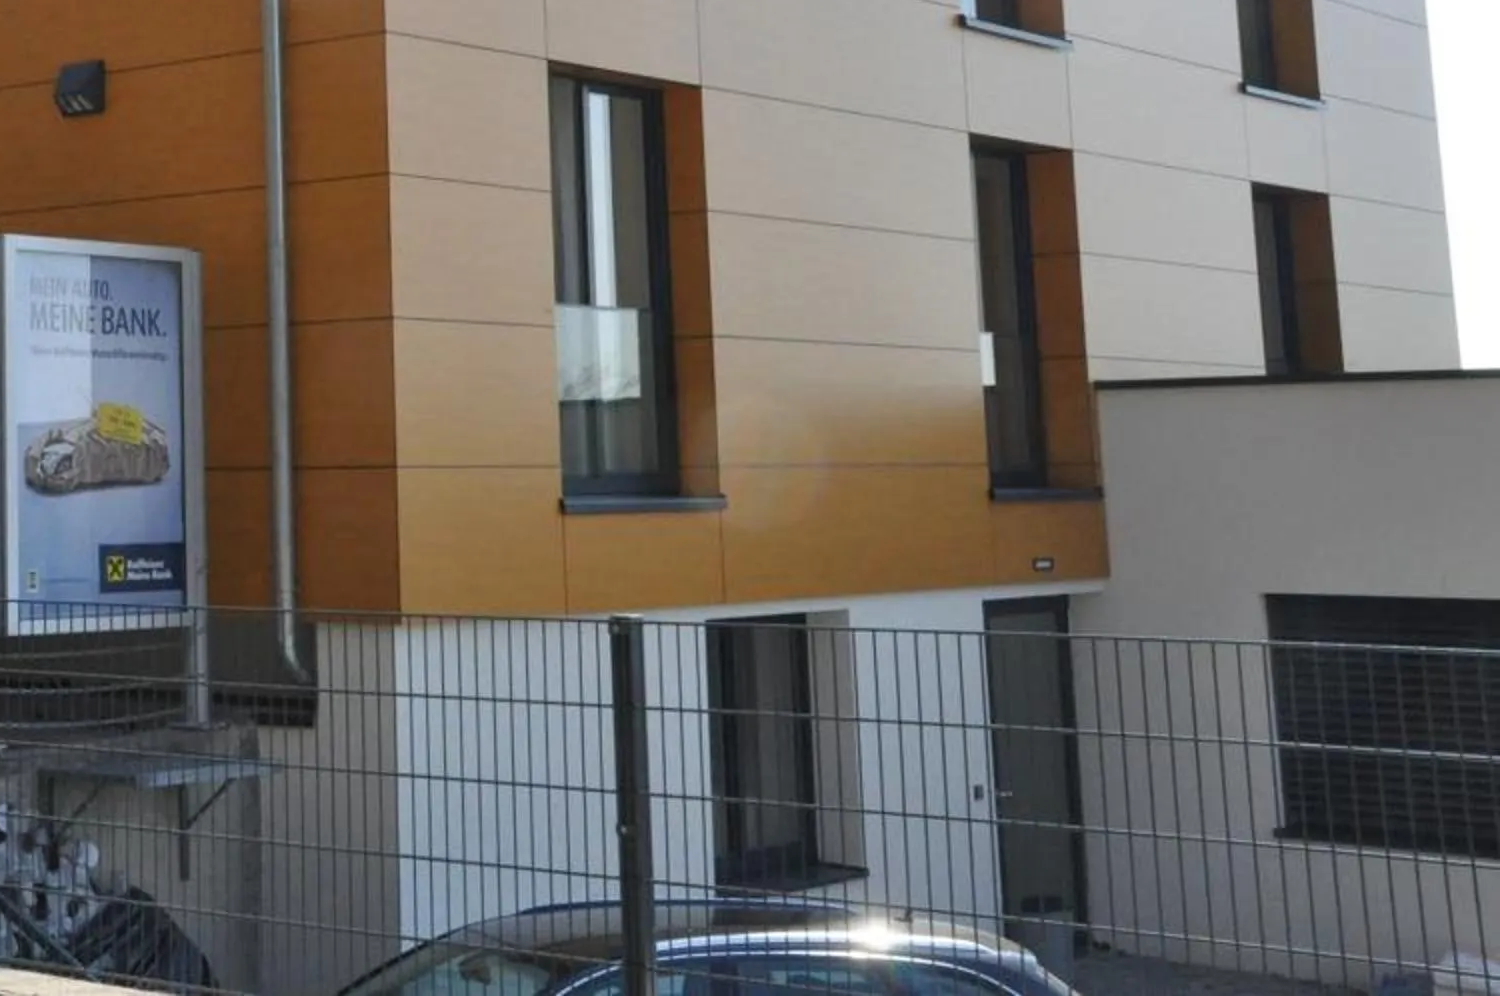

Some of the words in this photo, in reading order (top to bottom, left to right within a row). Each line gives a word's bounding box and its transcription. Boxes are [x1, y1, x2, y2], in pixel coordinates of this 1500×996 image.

[29, 276, 68, 298] MEIN
[29, 302, 97, 335] MEINE
[101, 305, 168, 338] BANK.
